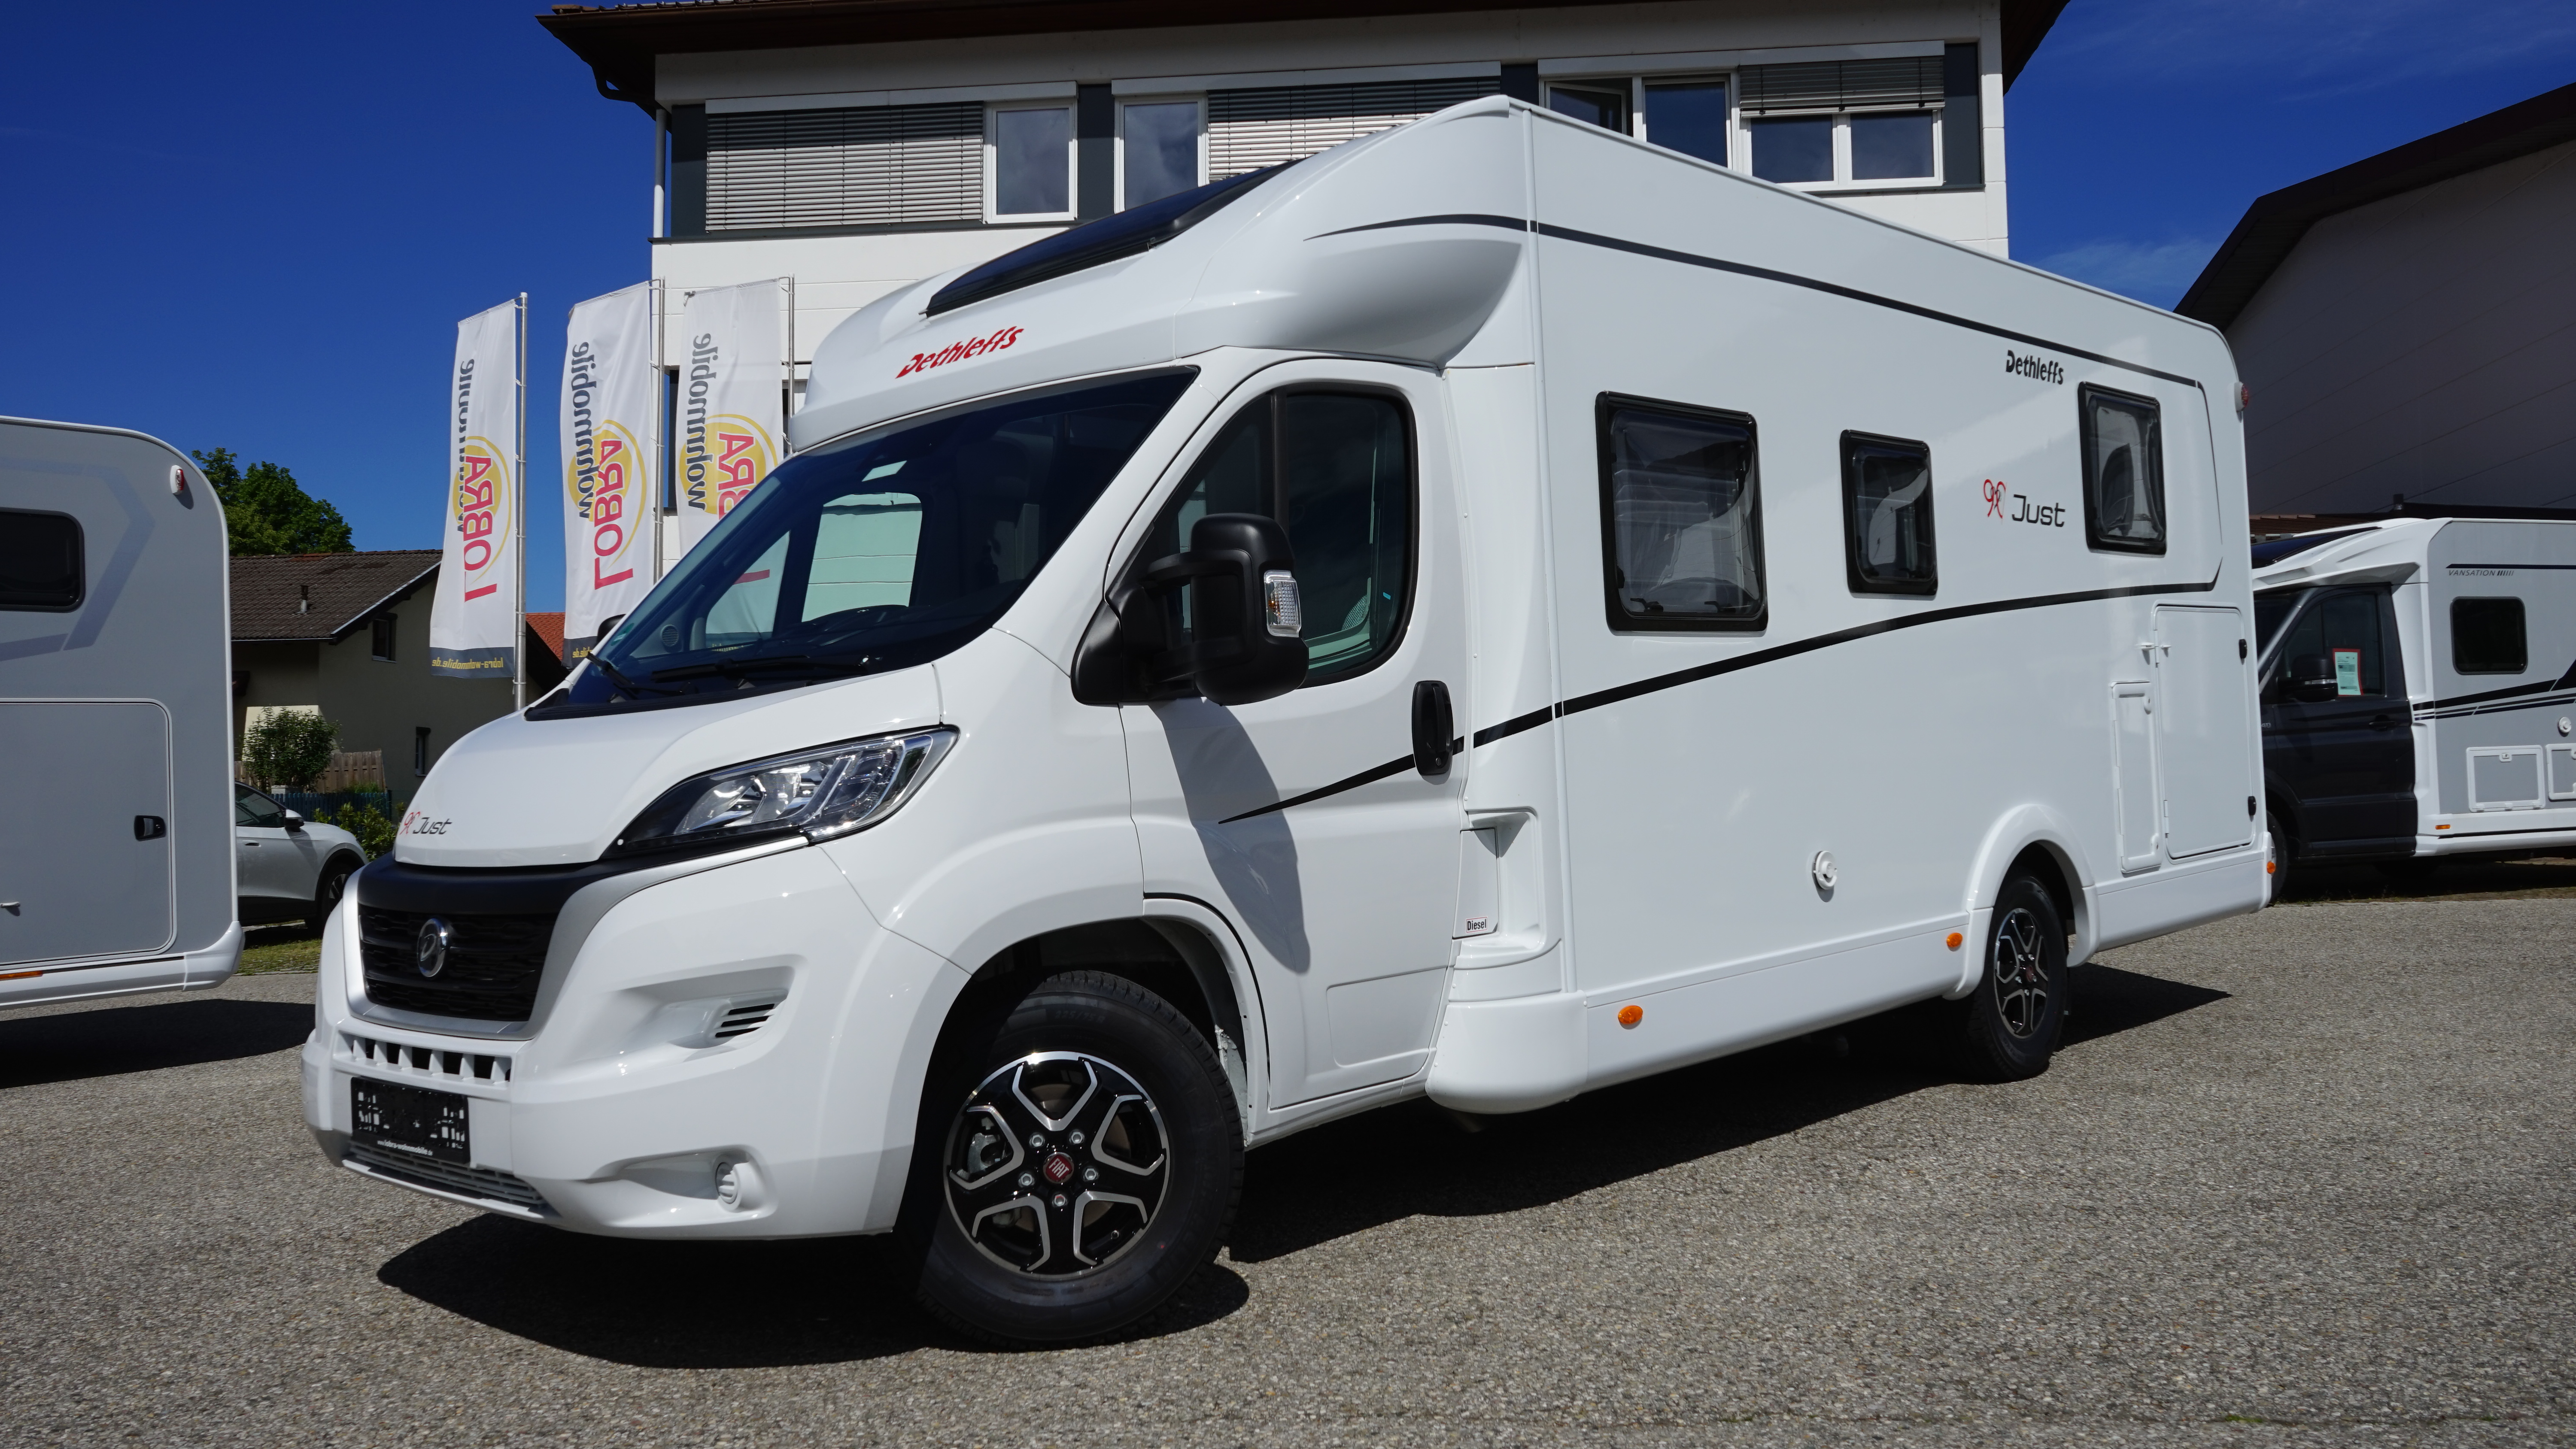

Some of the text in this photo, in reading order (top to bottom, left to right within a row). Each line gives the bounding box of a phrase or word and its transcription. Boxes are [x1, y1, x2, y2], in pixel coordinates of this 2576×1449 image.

[895, 326, 1024, 379] Dethleffs
[2005, 350, 2064, 385] Dethleffs
[2012, 494, 2066, 527] Just
[413, 817, 452, 834] Just
[1467, 919, 1486, 931] Diesel
[1048, 1158, 1069, 1178] FIAT
